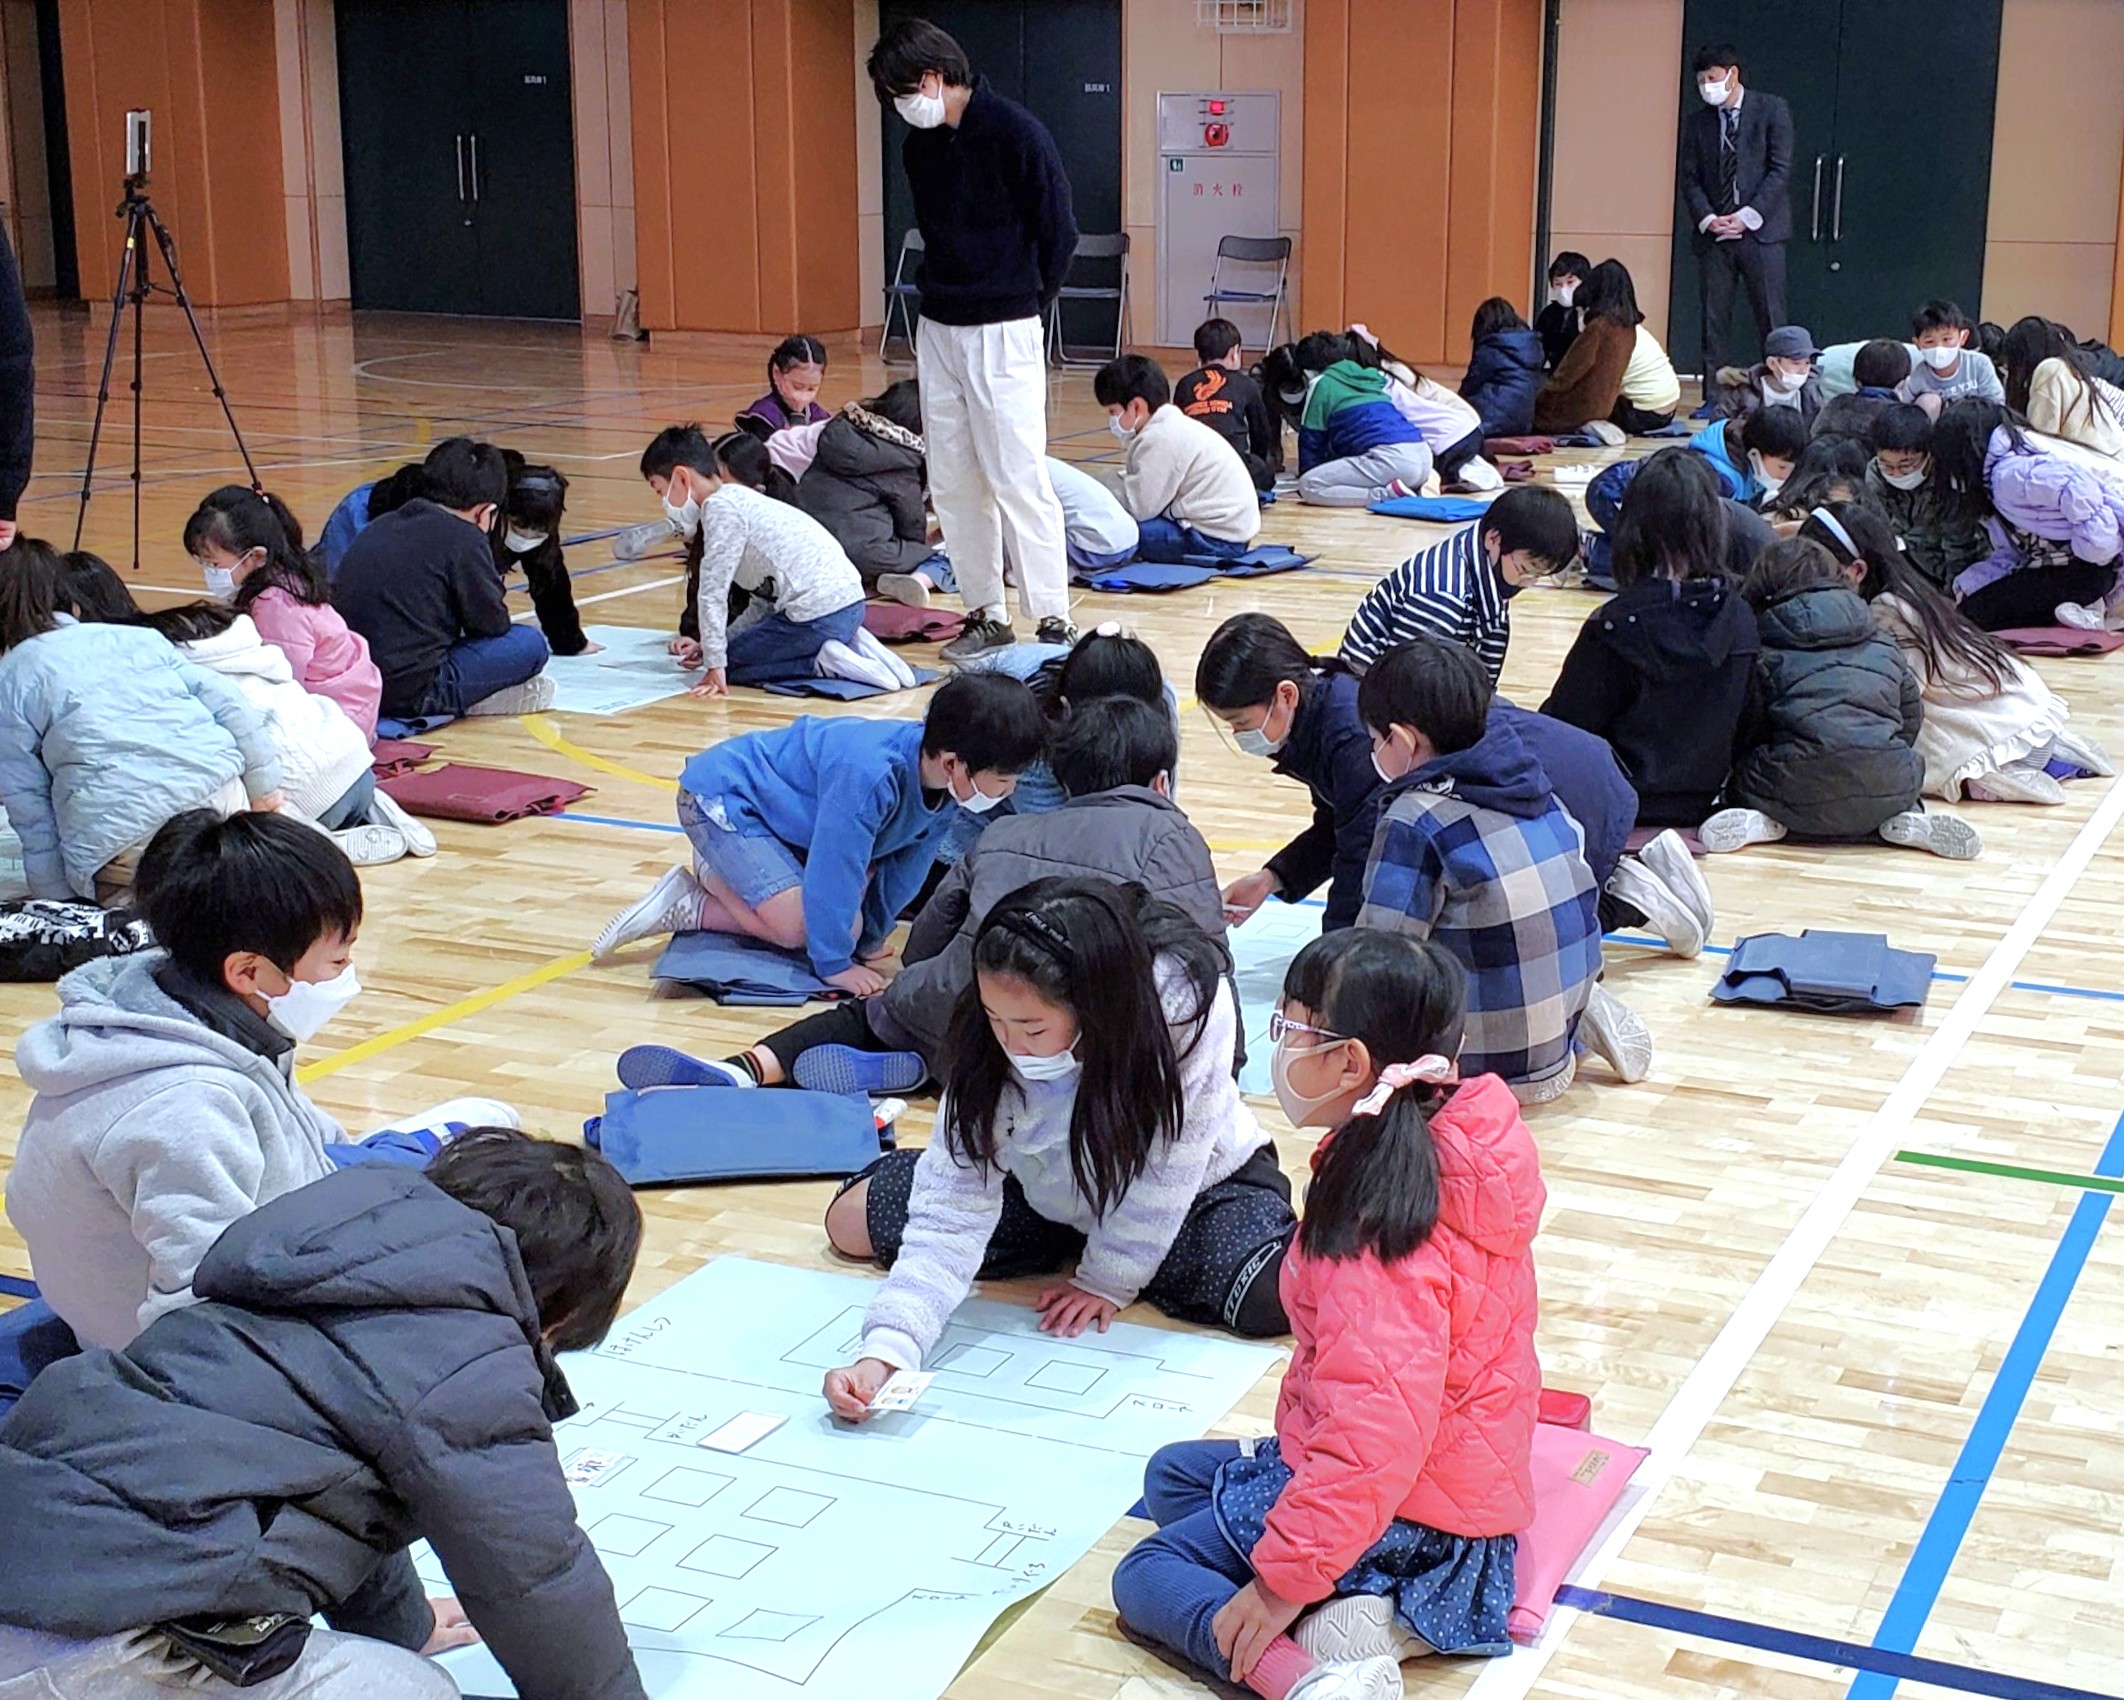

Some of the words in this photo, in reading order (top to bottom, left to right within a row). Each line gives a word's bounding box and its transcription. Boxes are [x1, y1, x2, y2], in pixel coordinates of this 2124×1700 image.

[1193, 183, 1243, 197] 消火栓
[1958, 379, 1978, 393] YOU
[603, 1316, 671, 1356] ほけんしつ
